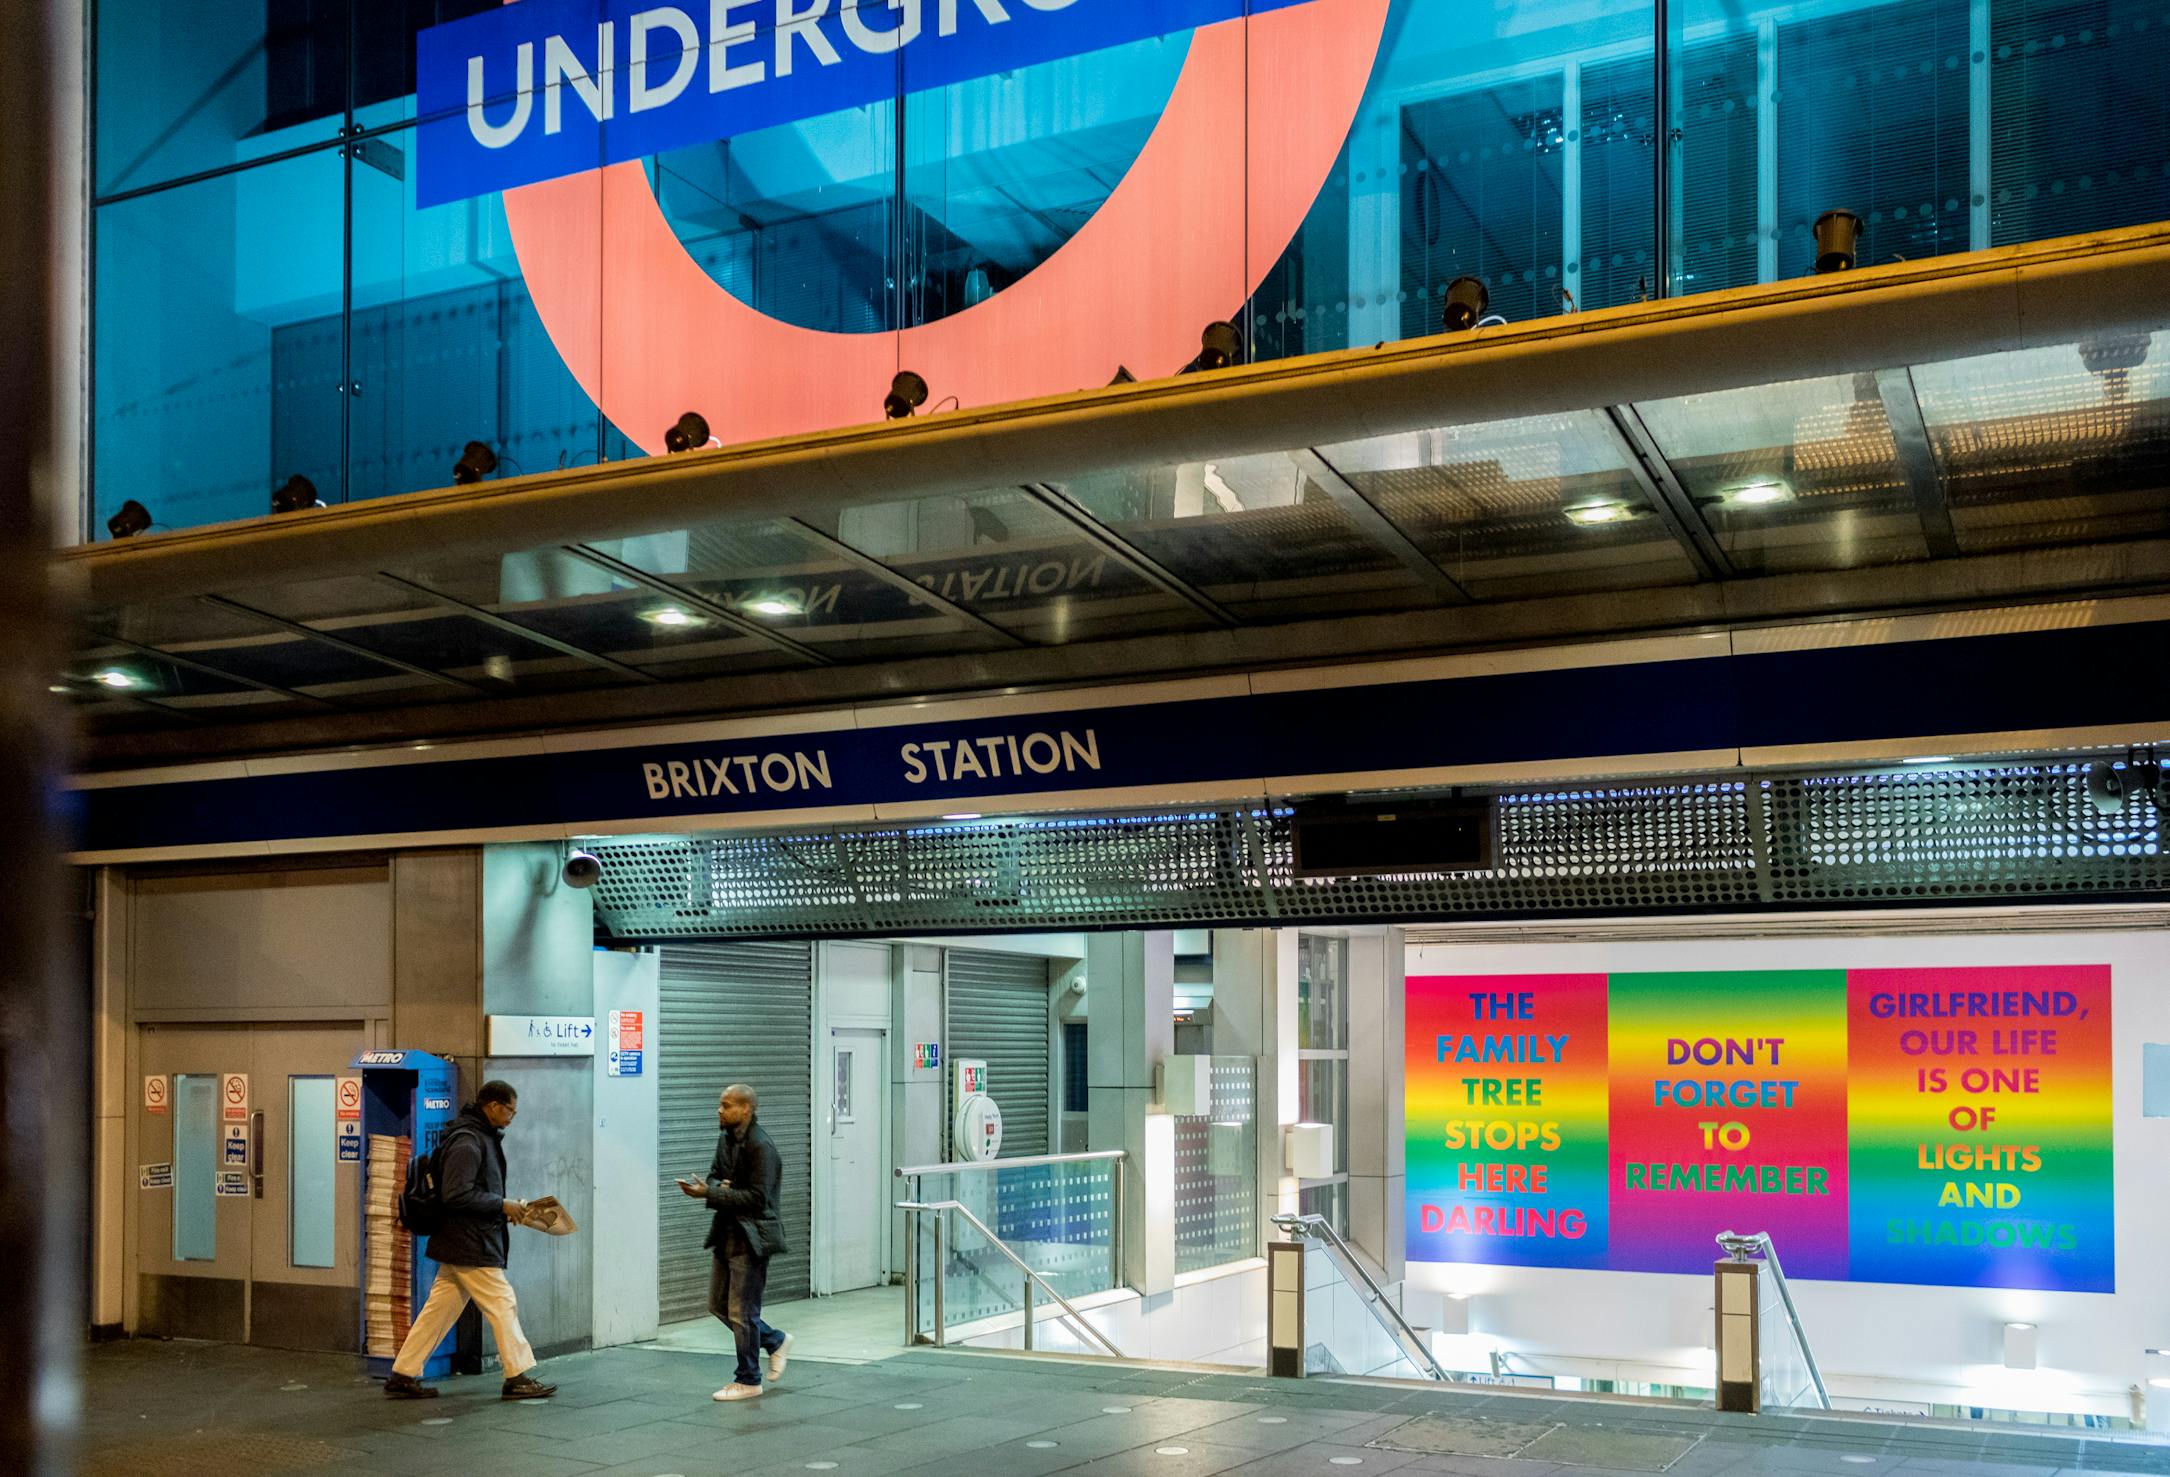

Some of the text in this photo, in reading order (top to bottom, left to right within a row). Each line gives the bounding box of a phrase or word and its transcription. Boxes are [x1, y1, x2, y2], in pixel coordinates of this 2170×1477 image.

[642, 728, 1101, 800] BRIXTON STATION
[1469, 992, 1534, 1020] THE
[1869, 991, 2090, 1021] GIRLFRIEND,
[557, 1023, 579, 1038] Lift
[1900, 1029, 2057, 1056] OUR LIFE
[360, 1052, 404, 1065] METRO
[1436, 1034, 1570, 1064] FAMILY
[1666, 1037, 1785, 1066] DON'T
[1461, 1078, 1542, 1106] TREE
[1653, 1079, 1800, 1109] FORGET
[1917, 1068, 2040, 1094] IS ONE
[425, 1099, 449, 1110] METRO
[1948, 1106, 1996, 1132] OF
[227, 1141, 245, 1150] Keep
[341, 1138, 360, 1149] Keep
[1445, 1120, 1562, 1151] STOPS
[1698, 1121, 1751, 1151] TO
[228, 1153, 244, 1163] clear
[340, 1150, 359, 1159] clear
[1917, 1143, 2043, 1173] LIGHTS
[1457, 1162, 1548, 1194] HERE
[1625, 1162, 1830, 1195] REMEMBER
[1937, 1181, 2022, 1209] AND
[1420, 1204, 1588, 1240] DARLING
[1886, 1218, 2078, 1251] SHADOWS
